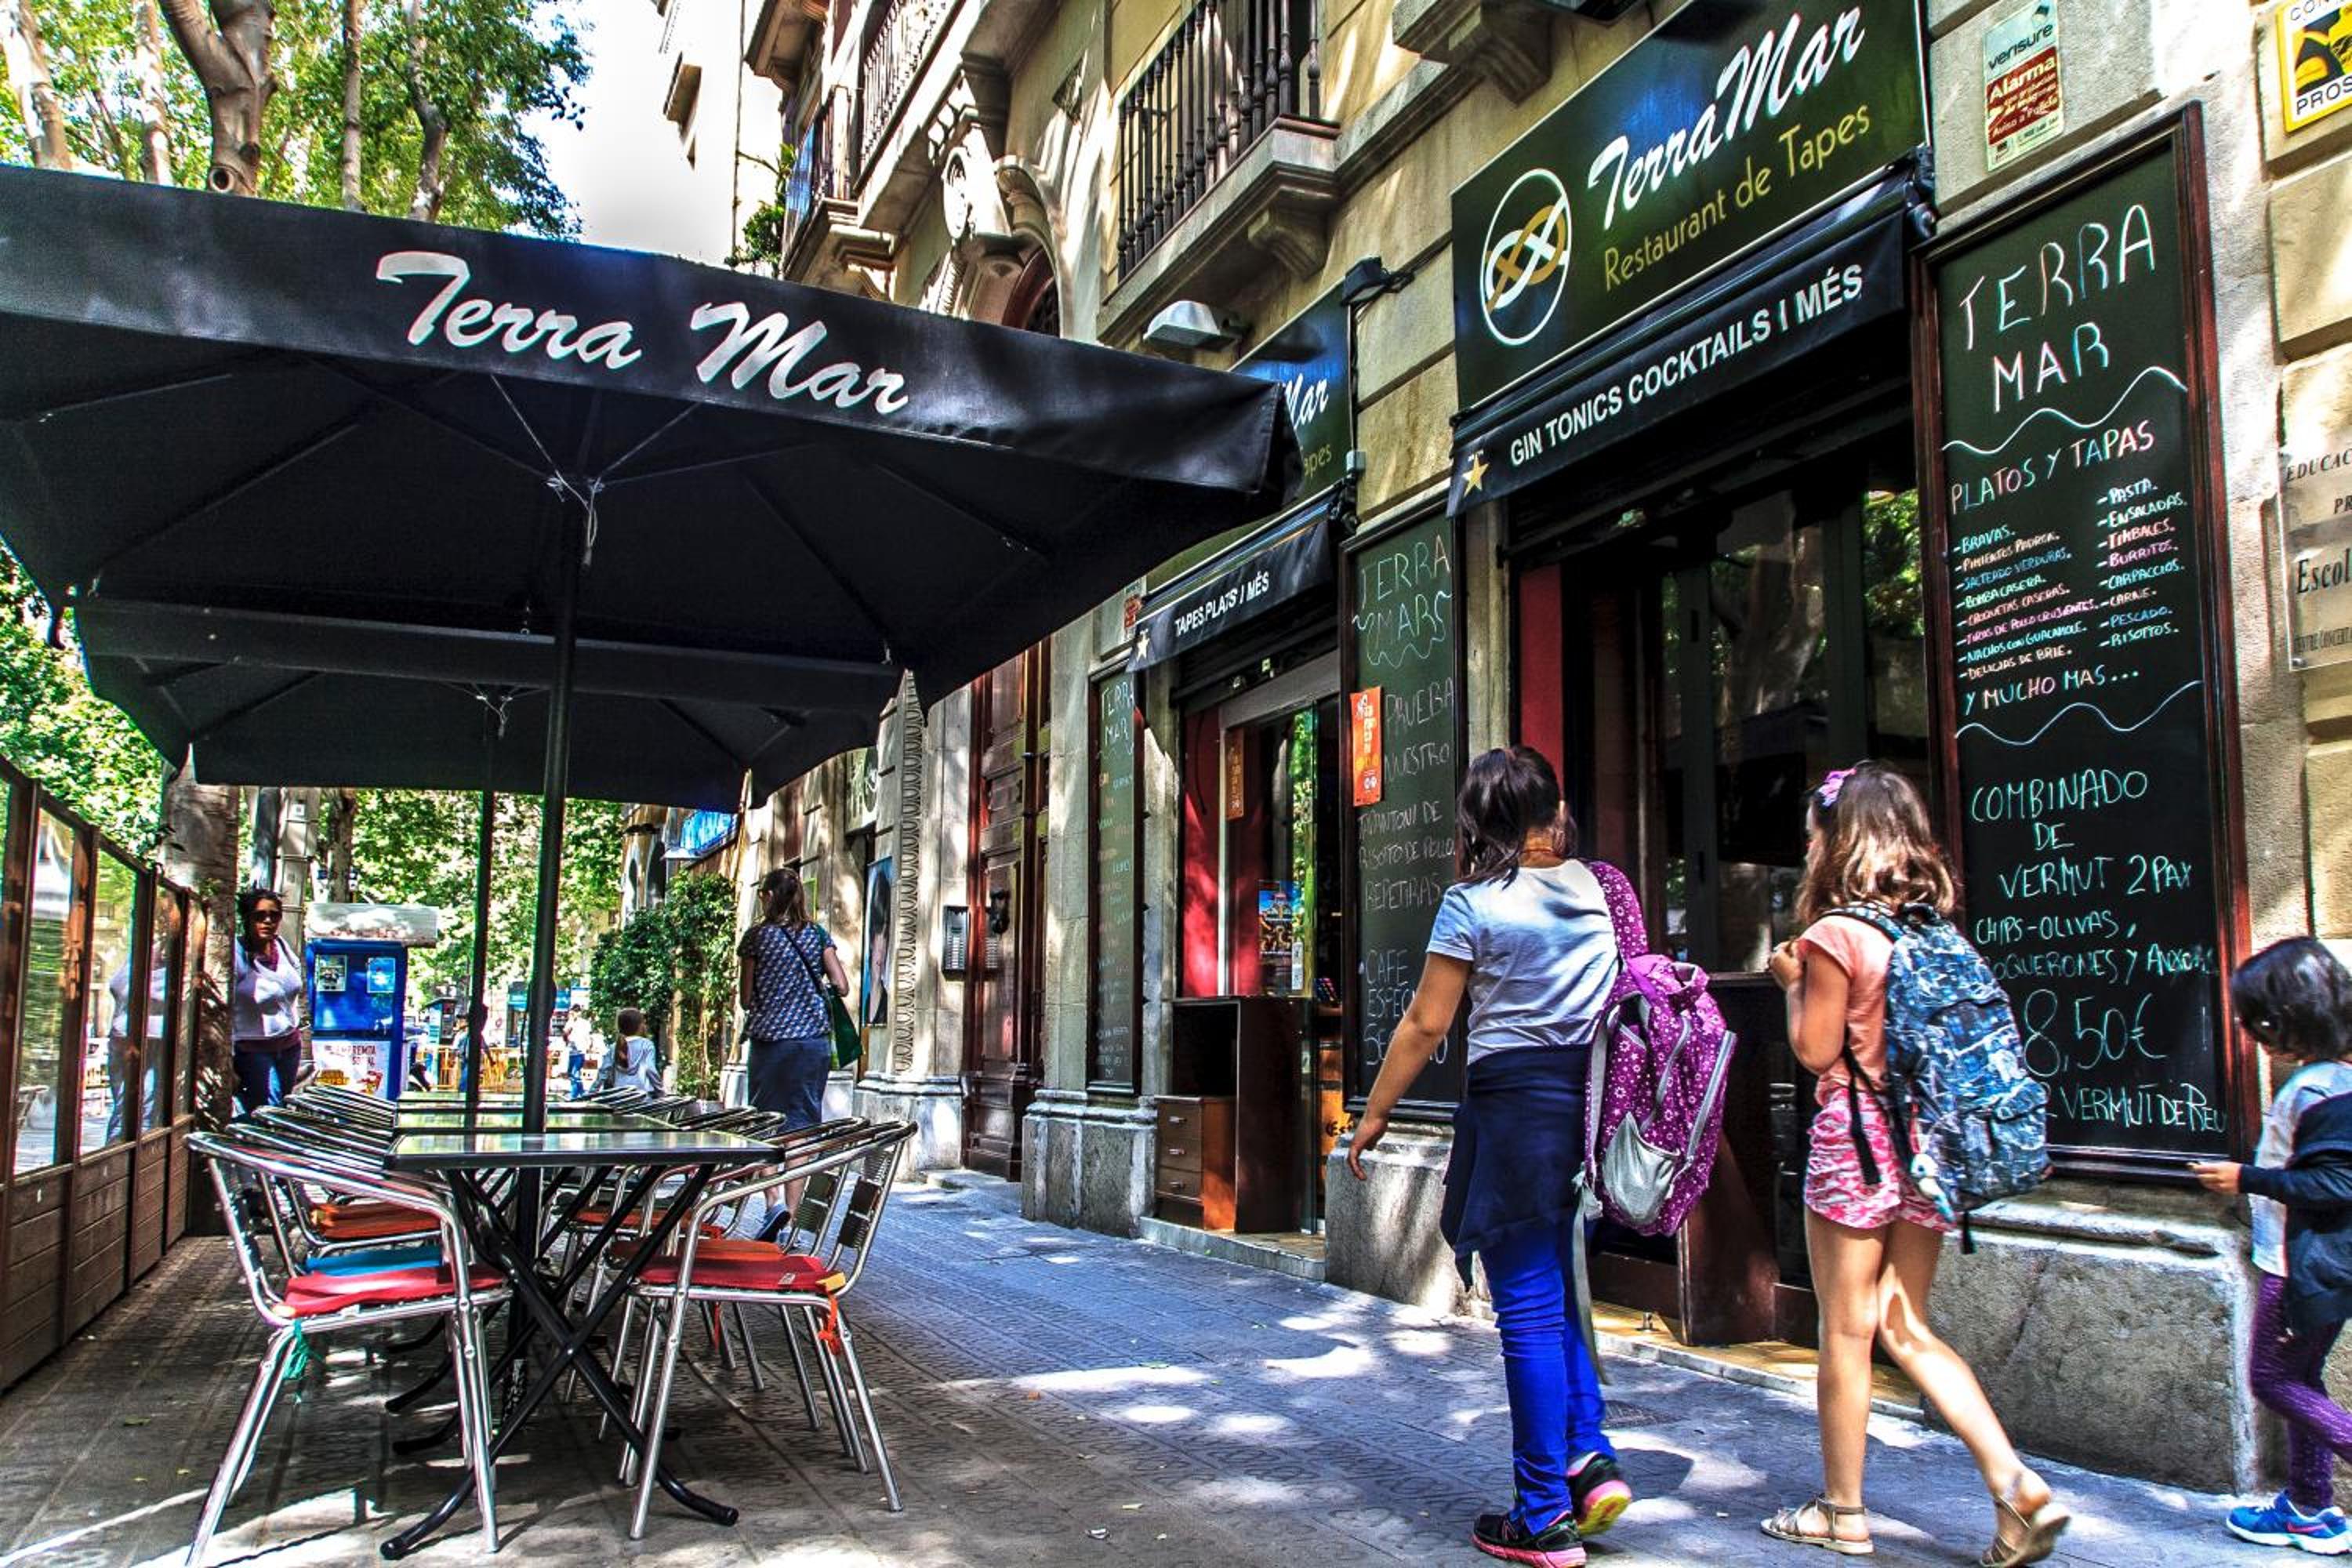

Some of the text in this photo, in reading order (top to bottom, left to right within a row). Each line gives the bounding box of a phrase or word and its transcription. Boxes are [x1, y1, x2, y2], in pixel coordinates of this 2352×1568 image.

[1988, 24, 2053, 70] verisure
[1990, 56, 2056, 103] Alarma
[1604, 104, 1871, 292] Restaurant de Tapes
[1959, 203, 2156, 350] TERRA
[376, 251, 909, 414] Terra Mar
[1509, 263, 1864, 466] GIN TONICS COCKTAILS I MÉS
[1993, 321, 2109, 413] MAR
[1951, 457, 2037, 514] PLATOS
[2071, 419, 2156, 469] TAPAS
[1360, 534, 1451, 609] TERRA
[1174, 606, 1204, 637] TAPES
[1205, 587, 1238, 621] PLATS
[1247, 571, 1269, 601] MÉS
[1994, 622, 2009, 636] DE
[2019, 652, 2034, 666] DE
[1965, 691, 1976, 715] Y
[1983, 676, 2056, 710] MUCHO
[1423, 800, 1443, 824] DE
[1972, 768, 2147, 822] COMBINADO
[2034, 822, 2075, 851] DE
[2000, 856, 2115, 899] VERMUT
[1985, 949, 2118, 985] OQUERONES
[2125, 947, 2138, 985] Y
[2024, 989, 2167, 1077] 8,50€
[2060, 1083, 2158, 1128] VERMUT
[2157, 1094, 2186, 1126] DE
